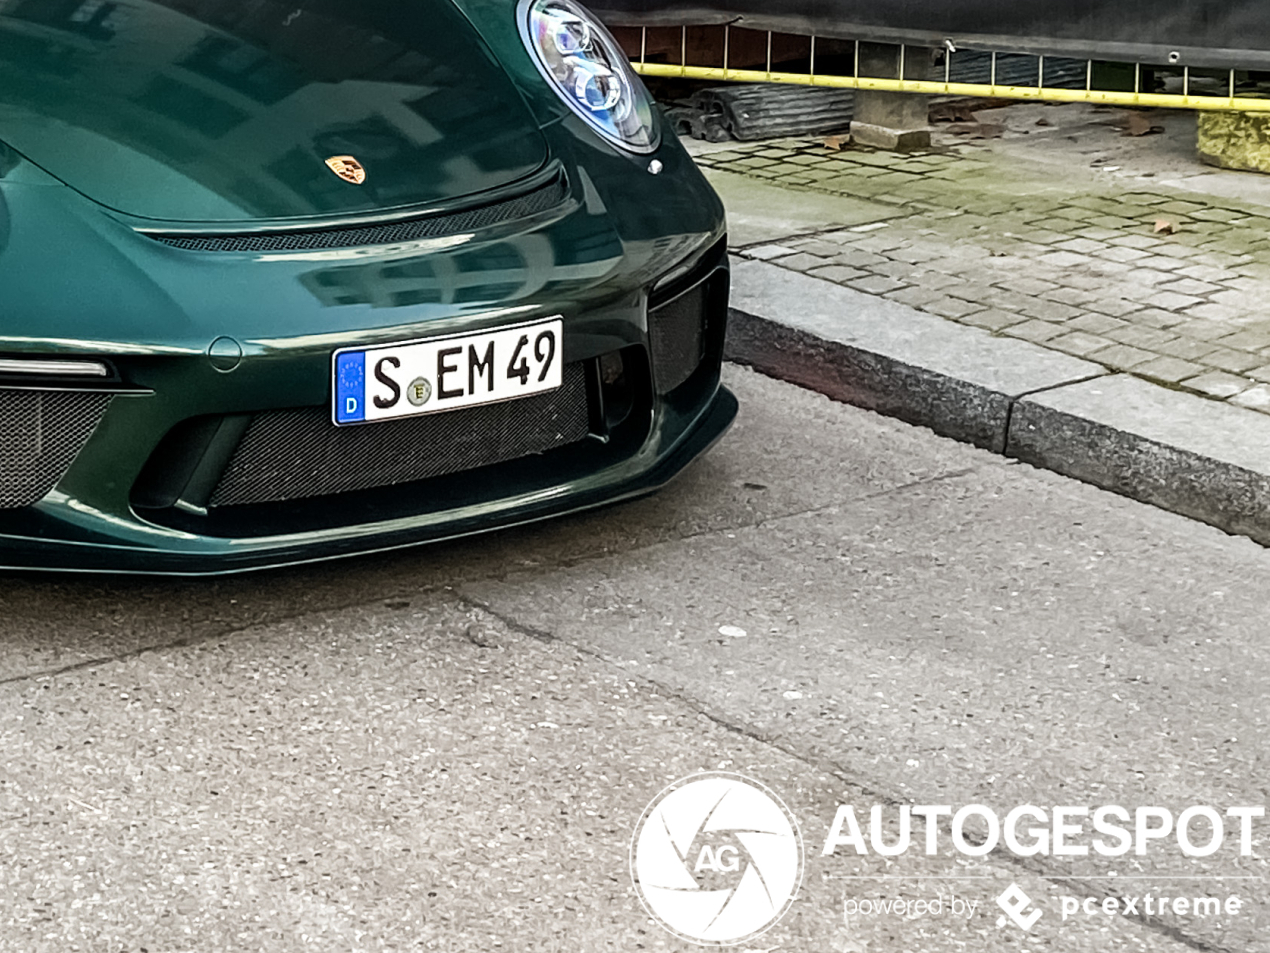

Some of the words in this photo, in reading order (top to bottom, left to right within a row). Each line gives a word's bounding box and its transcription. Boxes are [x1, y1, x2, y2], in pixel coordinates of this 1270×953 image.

[373, 356, 401, 409] S
[437, 340, 495, 400] EM
[507, 329, 555, 385] 49
[346, 398, 358, 414] D
